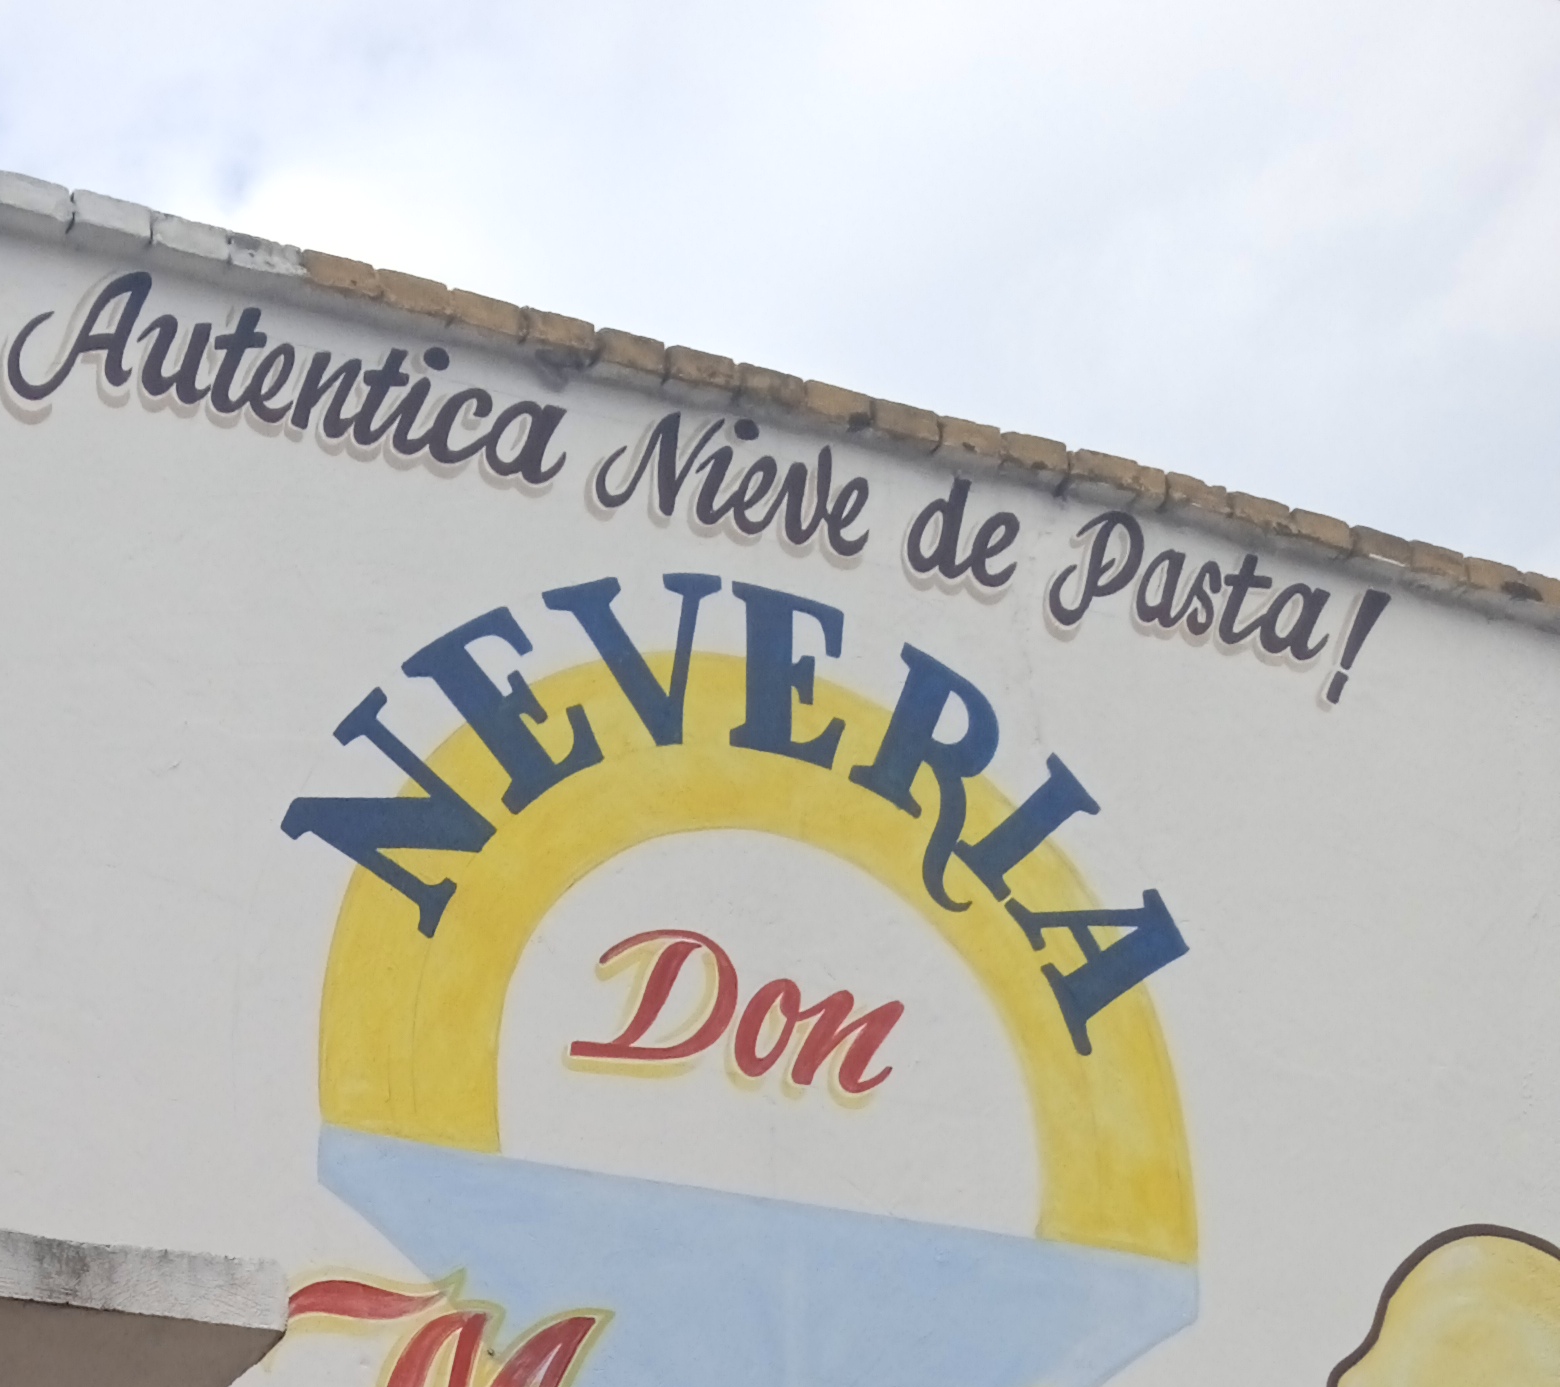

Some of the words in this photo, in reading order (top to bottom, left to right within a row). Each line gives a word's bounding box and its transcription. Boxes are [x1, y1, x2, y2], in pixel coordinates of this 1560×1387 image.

[6, 271, 567, 484] Autentica
[594, 411, 870, 557] Nieve
[906, 457, 1020, 588] de
[1048, 507, 1393, 704] Pasta!
[280, 572, 1189, 1057] NEVERIA
[570, 928, 905, 1094] Don
